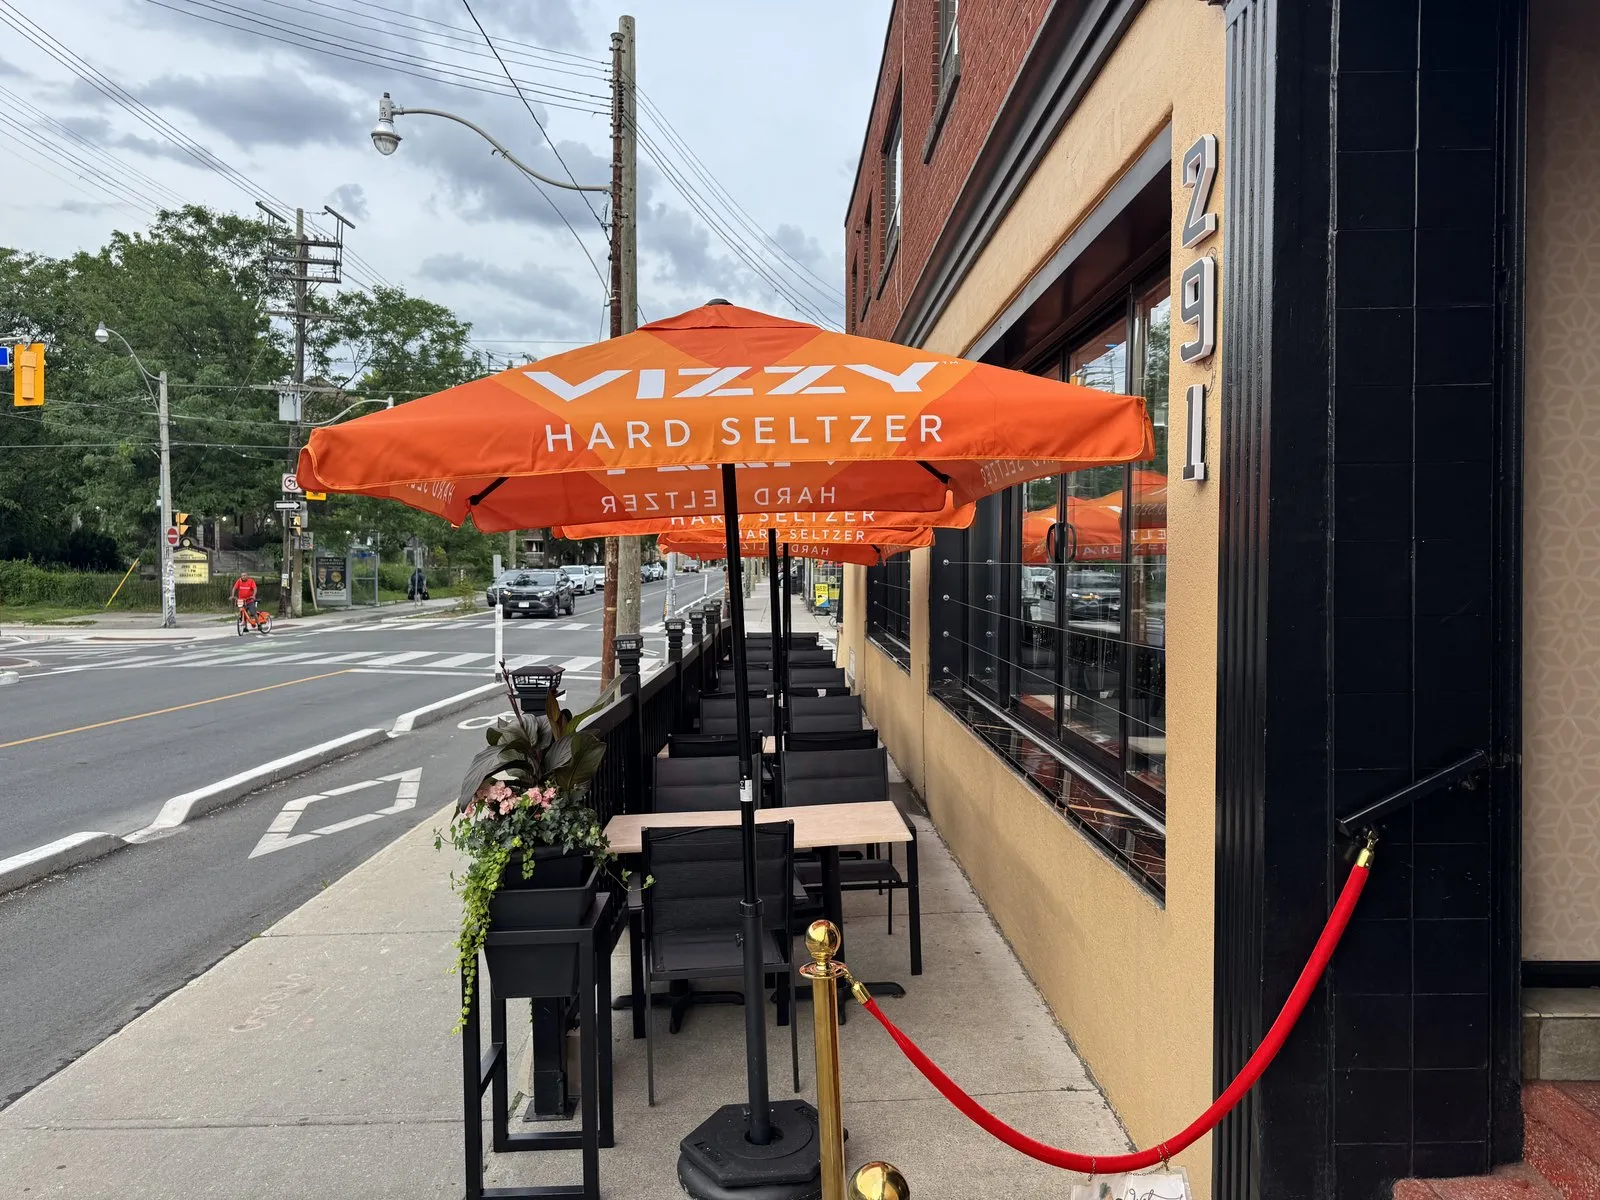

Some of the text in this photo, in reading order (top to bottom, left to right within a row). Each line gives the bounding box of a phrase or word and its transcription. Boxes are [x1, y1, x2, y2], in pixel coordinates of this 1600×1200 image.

[1181, 133, 1217, 482] 291
[521, 361, 940, 402] VIZZY
[545, 415, 943, 452] HARD SELTZER
[790, 529, 865, 541] SELTZER
